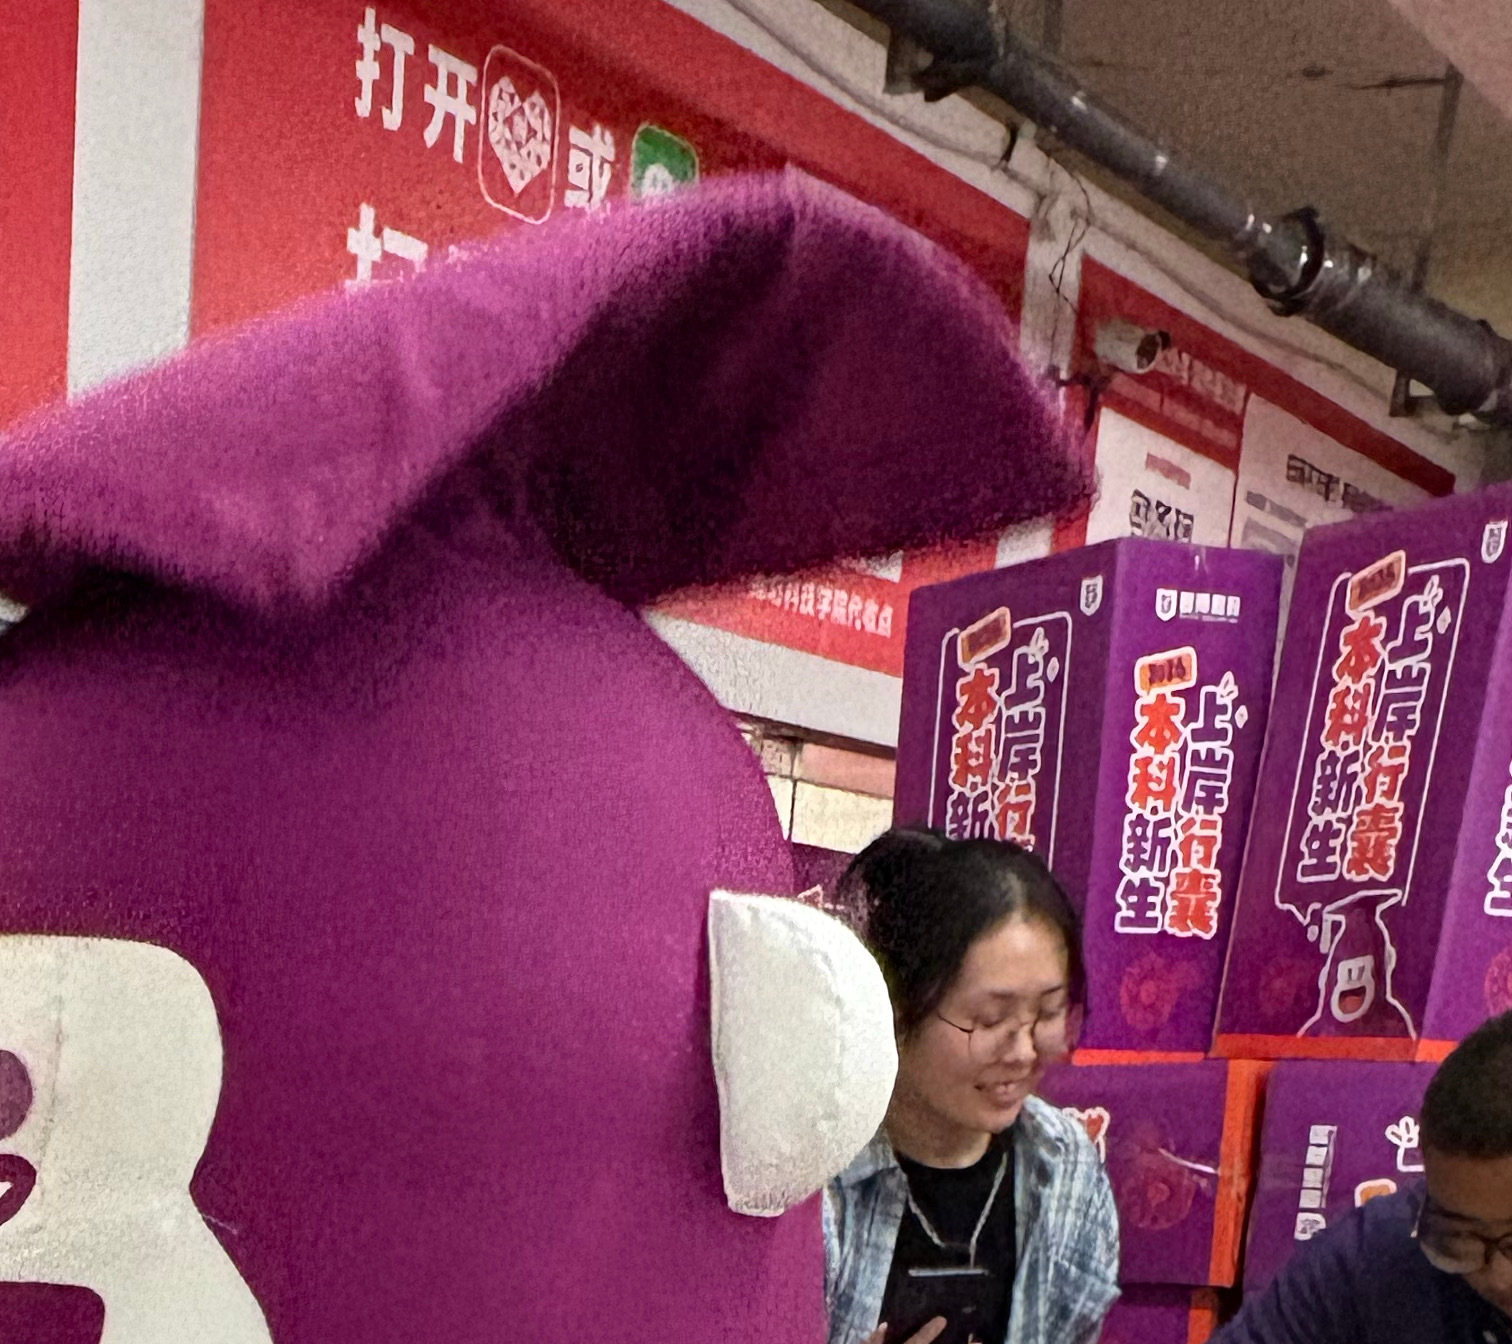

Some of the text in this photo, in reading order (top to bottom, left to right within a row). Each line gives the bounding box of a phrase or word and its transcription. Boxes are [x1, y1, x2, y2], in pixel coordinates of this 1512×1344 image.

[354, 6, 616, 210] 打开 或
[992, 644, 1047, 852] 上岸行
[1114, 688, 1187, 934] 本科新生
[1296, 609, 1387, 883] 本科新生
